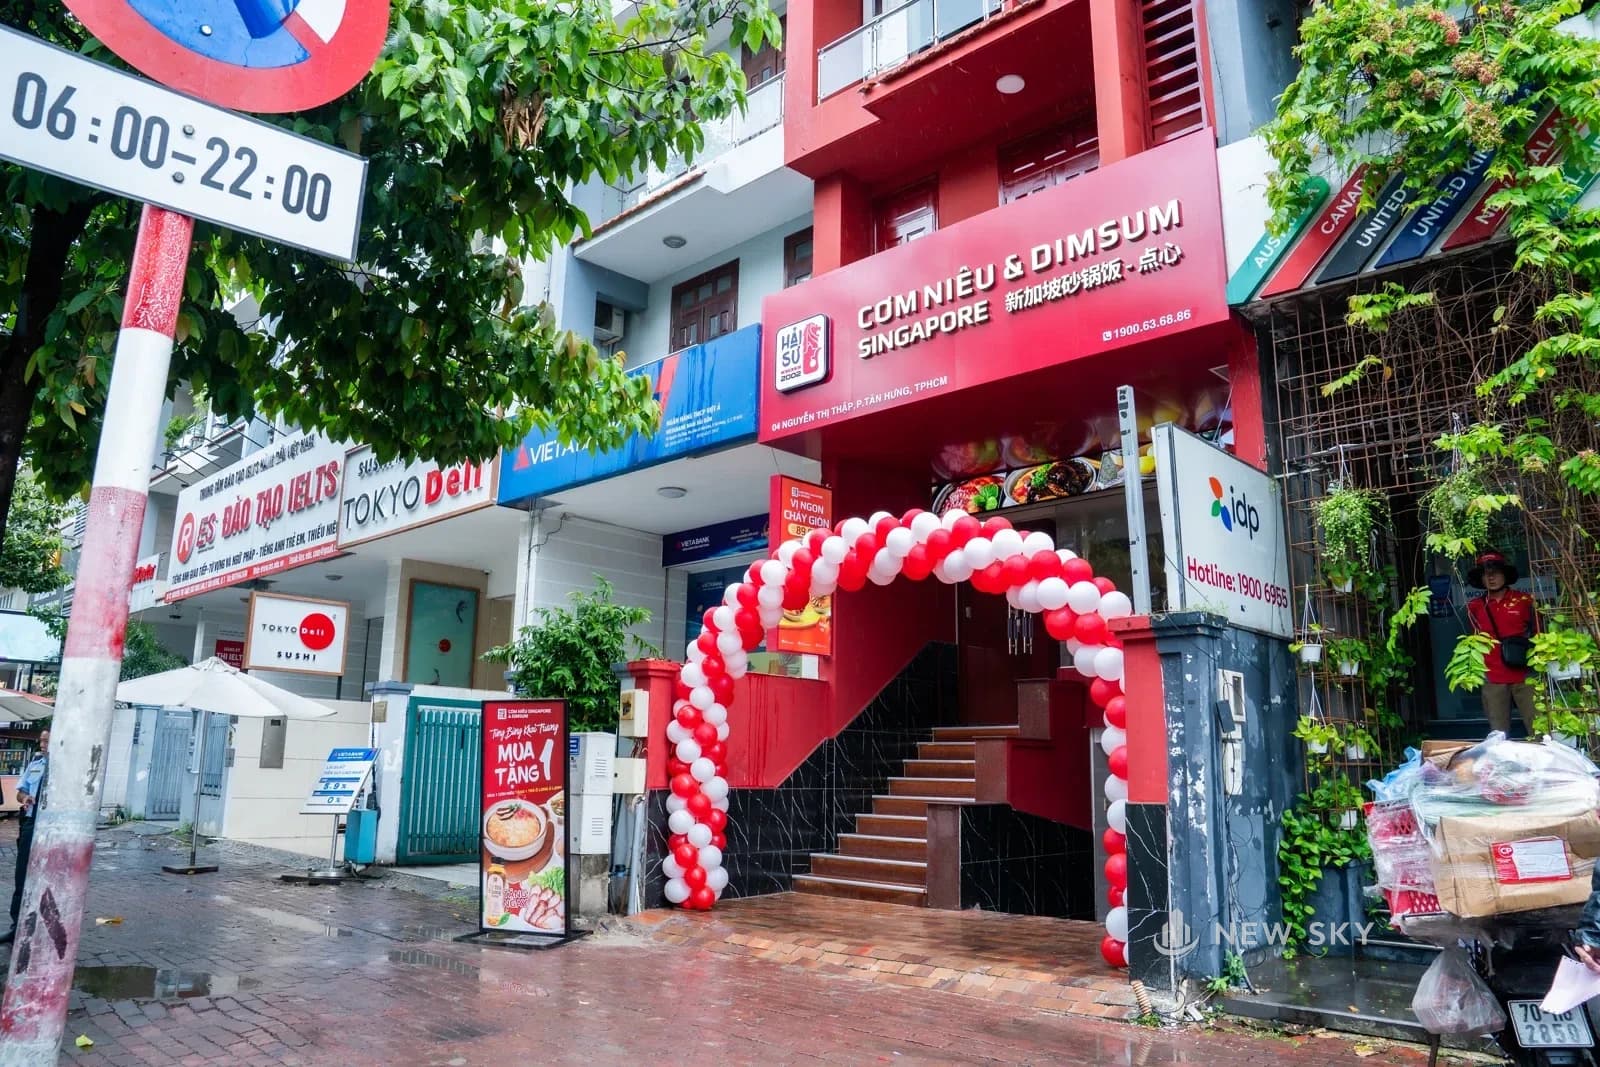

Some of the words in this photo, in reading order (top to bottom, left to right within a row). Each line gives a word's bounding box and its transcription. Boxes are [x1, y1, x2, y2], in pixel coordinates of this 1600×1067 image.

[1321, 178, 1366, 235] CANAD
[1356, 188, 1408, 248] UNITED
[1412, 176, 1466, 237] UNITED
[857, 291, 917, 329] CƠM
[923, 262, 995, 311] NIÊU
[1003, 253, 1024, 280] &
[1030, 200, 1182, 272] DIMSUM
[858, 300, 989, 358] SINGAPORE
[1113, 308, 1192, 339] 1900.63.68.86
[780, 371, 802, 382] 2002
[771, 421, 781, 432] 04
[914, 376, 948, 393] TPHCM
[221, 496, 251, 539] ĐÀO
[256, 484, 285, 529] TẠO
[288, 460, 340, 514] IELTS
[344, 476, 421, 529] TOKYO
[800, 501, 824, 514] NGON
[1230, 485, 1260, 540] idp
[1187, 556, 1236, 592] Hotline:
[1238, 573, 1262, 600] 1900
[1264, 583, 1288, 608] 6955
[262, 623, 297, 634] TOKYO
[301, 627, 325, 637] Deli
[277, 651, 317, 662] SUSHI
[494, 761, 540, 789] TẶNG
[498, 741, 535, 763] MUA
[539, 738, 554, 781] 1
